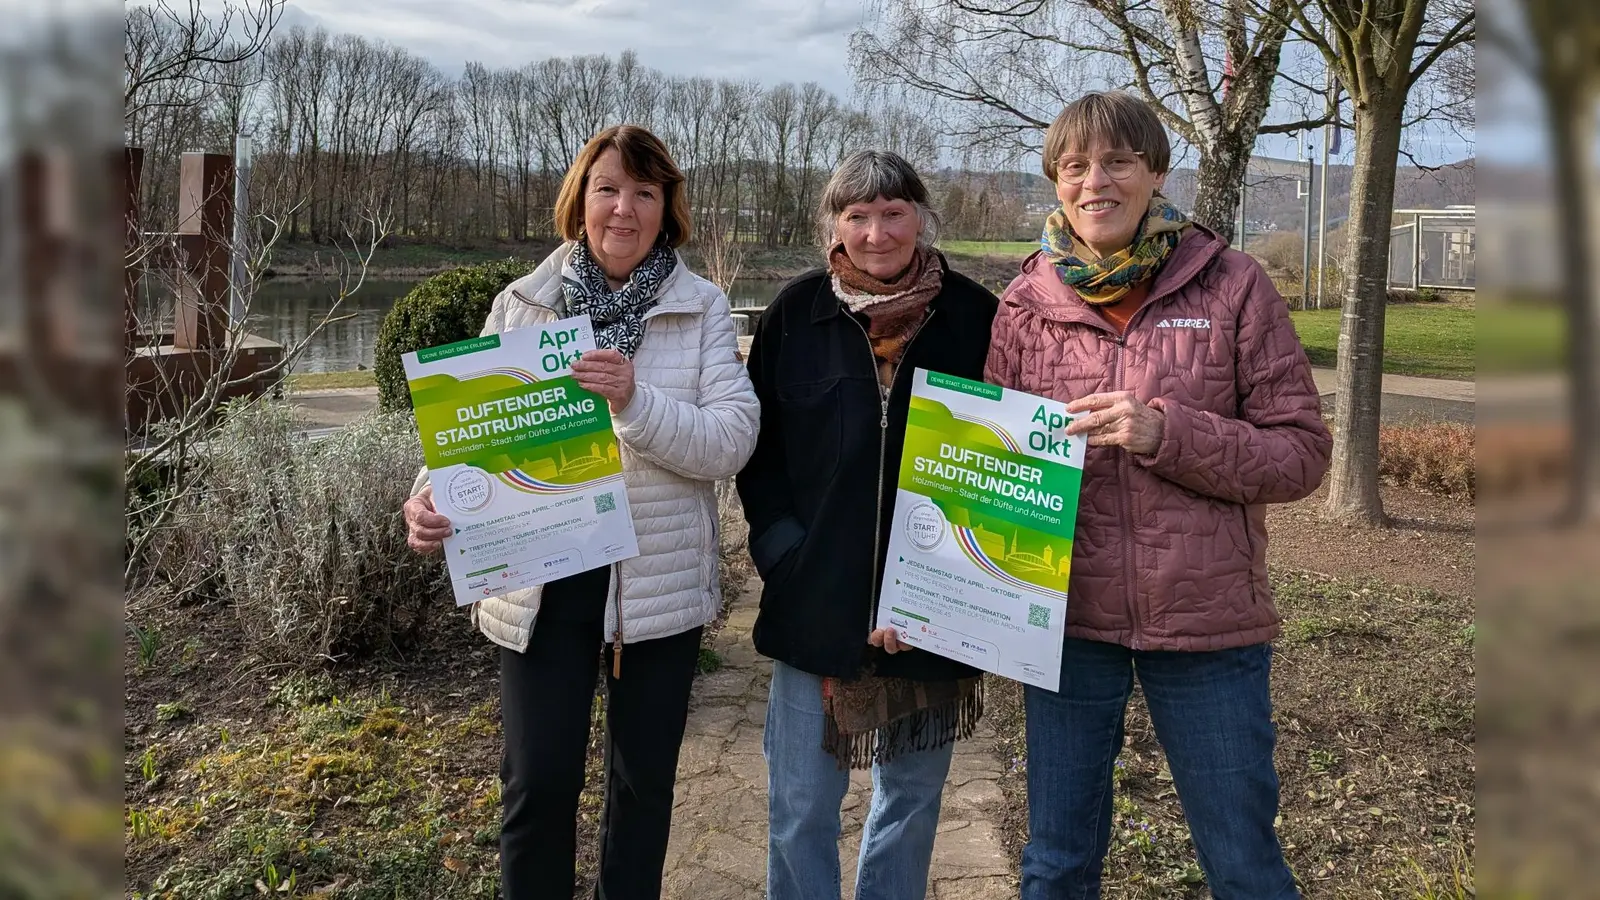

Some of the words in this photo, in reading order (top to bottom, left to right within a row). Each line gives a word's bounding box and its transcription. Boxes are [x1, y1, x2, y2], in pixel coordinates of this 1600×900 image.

[581, 326, 589, 340] bis
[1171, 319, 1210, 328] TERREX
[539, 328, 578, 350] Apr
[542, 350, 582, 372] Okt
[457, 387, 566, 423] DUFTENDER
[1031, 404, 1074, 432] Apr
[435, 399, 594, 446] STADTRUNDGANG
[439, 442, 484, 458] Holzminden
[491, 435, 512, 447] Stadt
[514, 432, 526, 442] der
[528, 427, 550, 440] Düfte
[552, 423, 566, 433] und
[568, 416, 598, 429] Aromen
[1029, 431, 1071, 458] Okt
[940, 443, 1042, 484] DUFTENDER
[458, 485, 484, 498] START:
[470, 491, 485, 502] UHR
[914, 457, 1063, 512] STADTRUNDGANG
[912, 475, 953, 493] Holzminden
[959, 488, 978, 500] Stadt
[980, 495, 992, 505] der
[993, 497, 1013, 511] Düfte
[1015, 503, 1028, 515] und
[1030, 507, 1061, 524] Aromen
[463, 522, 484, 532] JEDEN
[486, 514, 515, 526] SAMSTAG
[531, 504, 550, 513] APRIL
[914, 523, 937, 532] START:
[468, 536, 511, 552] TREFFPUNKT:
[513, 517, 581, 540] TOURIST-INFORMATION
[922, 532, 936, 540] UHR
[906, 558, 924, 570] JEDEN
[925, 565, 952, 579] SAMSTAG
[953, 574, 966, 583] VON
[967, 578, 984, 589] APRIL
[902, 581, 940, 599] TREFFPUNKT:
[942, 593, 1010, 622] TOURIST-INFORMATION
